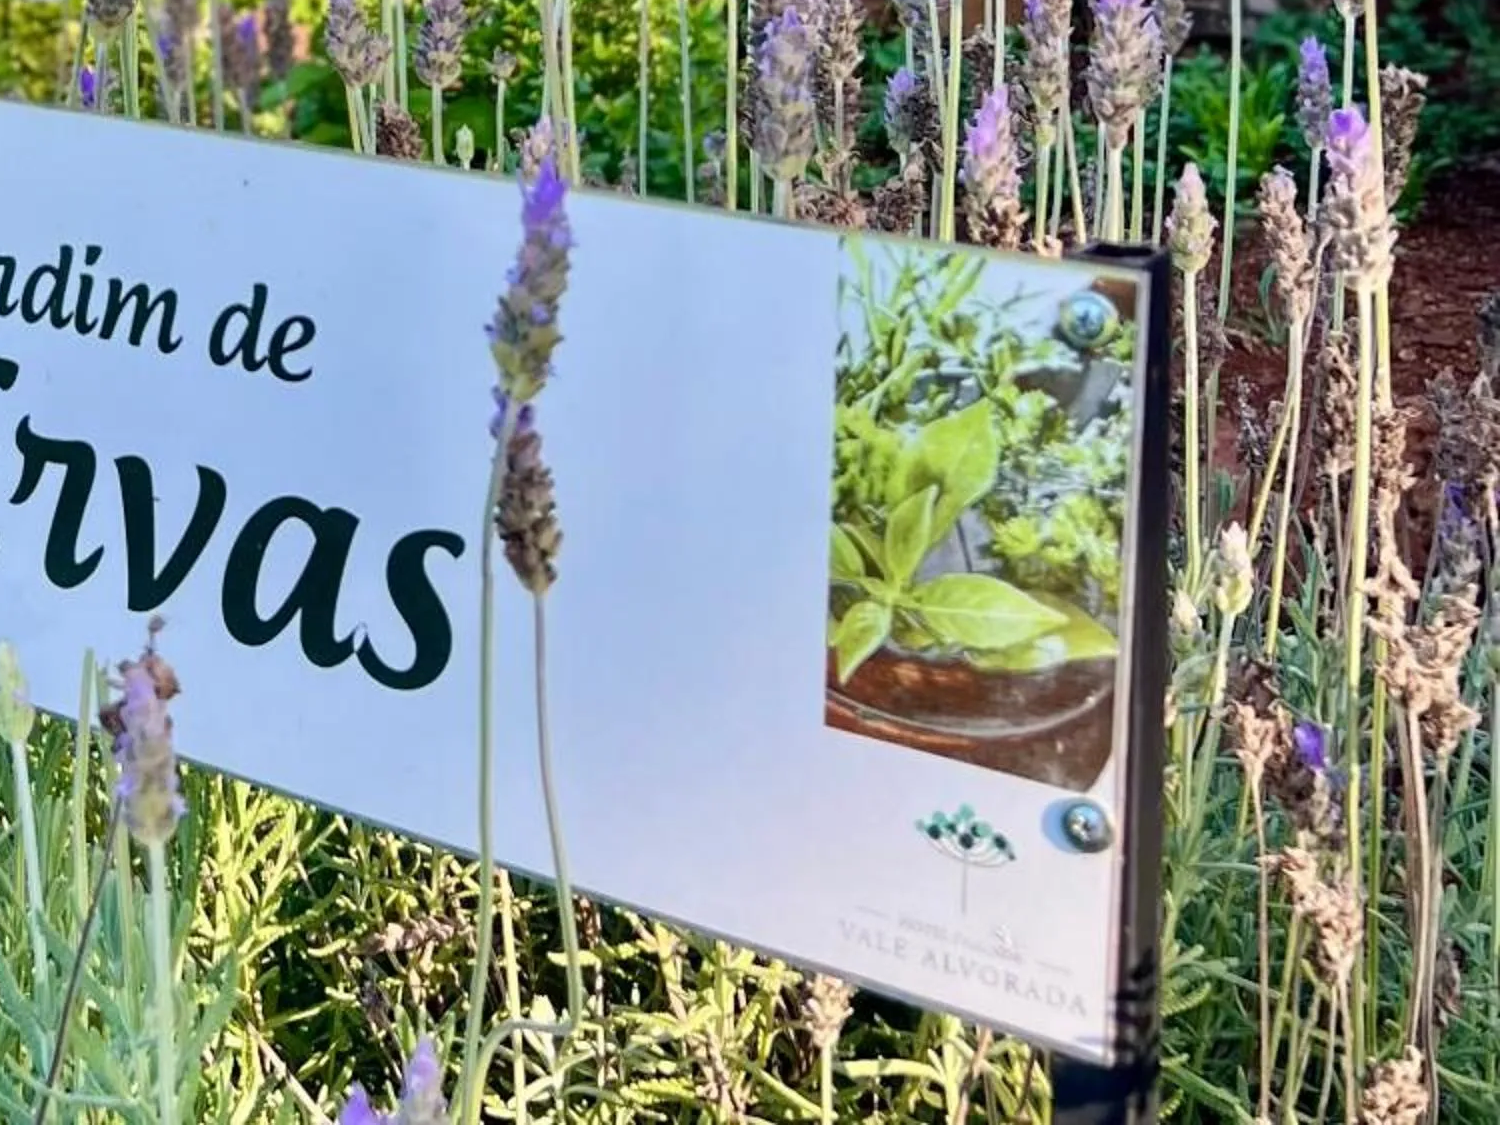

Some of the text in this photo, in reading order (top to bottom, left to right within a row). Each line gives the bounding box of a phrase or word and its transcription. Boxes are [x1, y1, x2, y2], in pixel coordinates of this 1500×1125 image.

[209, 283, 316, 382] de
[837, 918, 906, 959] VALE
[921, 951, 1088, 1017] ALVORADA
